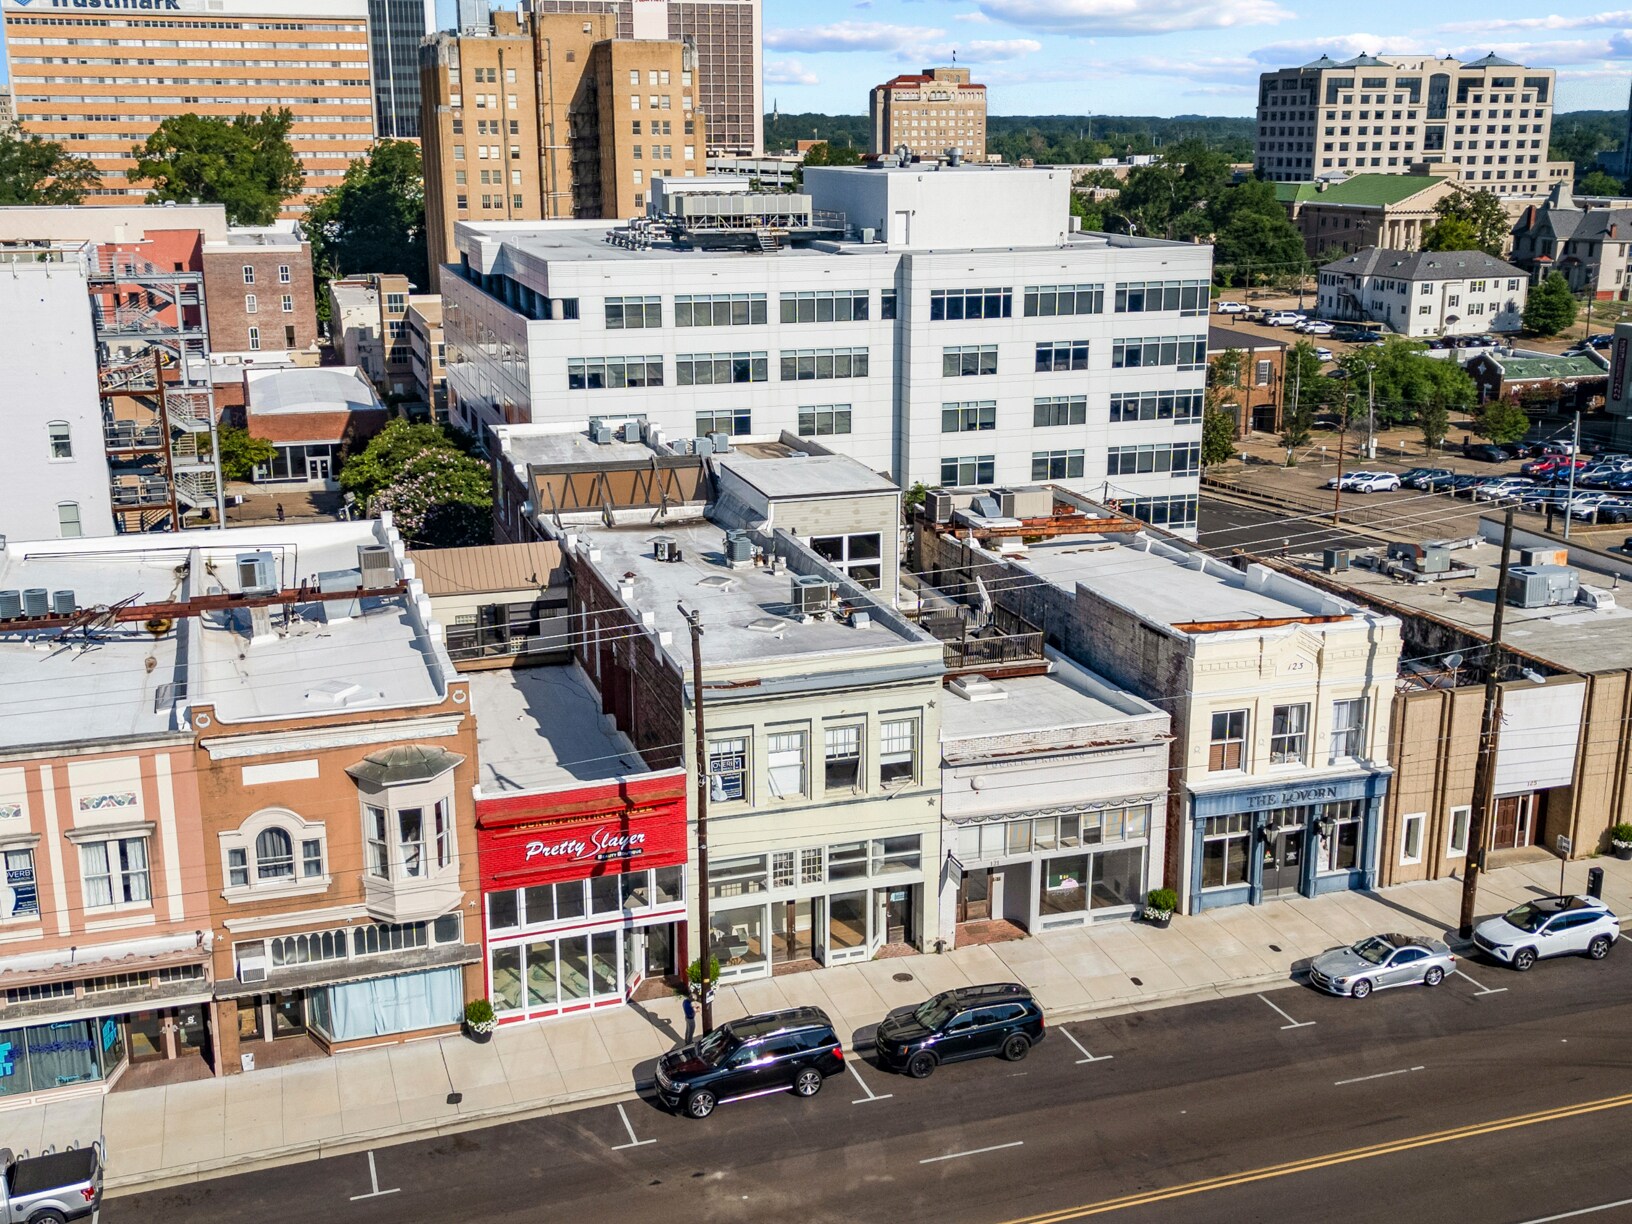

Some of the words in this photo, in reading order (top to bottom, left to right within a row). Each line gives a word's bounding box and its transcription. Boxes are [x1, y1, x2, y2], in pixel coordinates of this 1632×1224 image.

[1288, 662, 1304, 671] 123
[1247, 794, 1277, 808] THE
[1281, 786, 1338, 804] LOVORN
[526, 840, 586, 861] Pretty
[574, 827, 646, 860] Slayer
[7, 870, 33, 879] VERB
